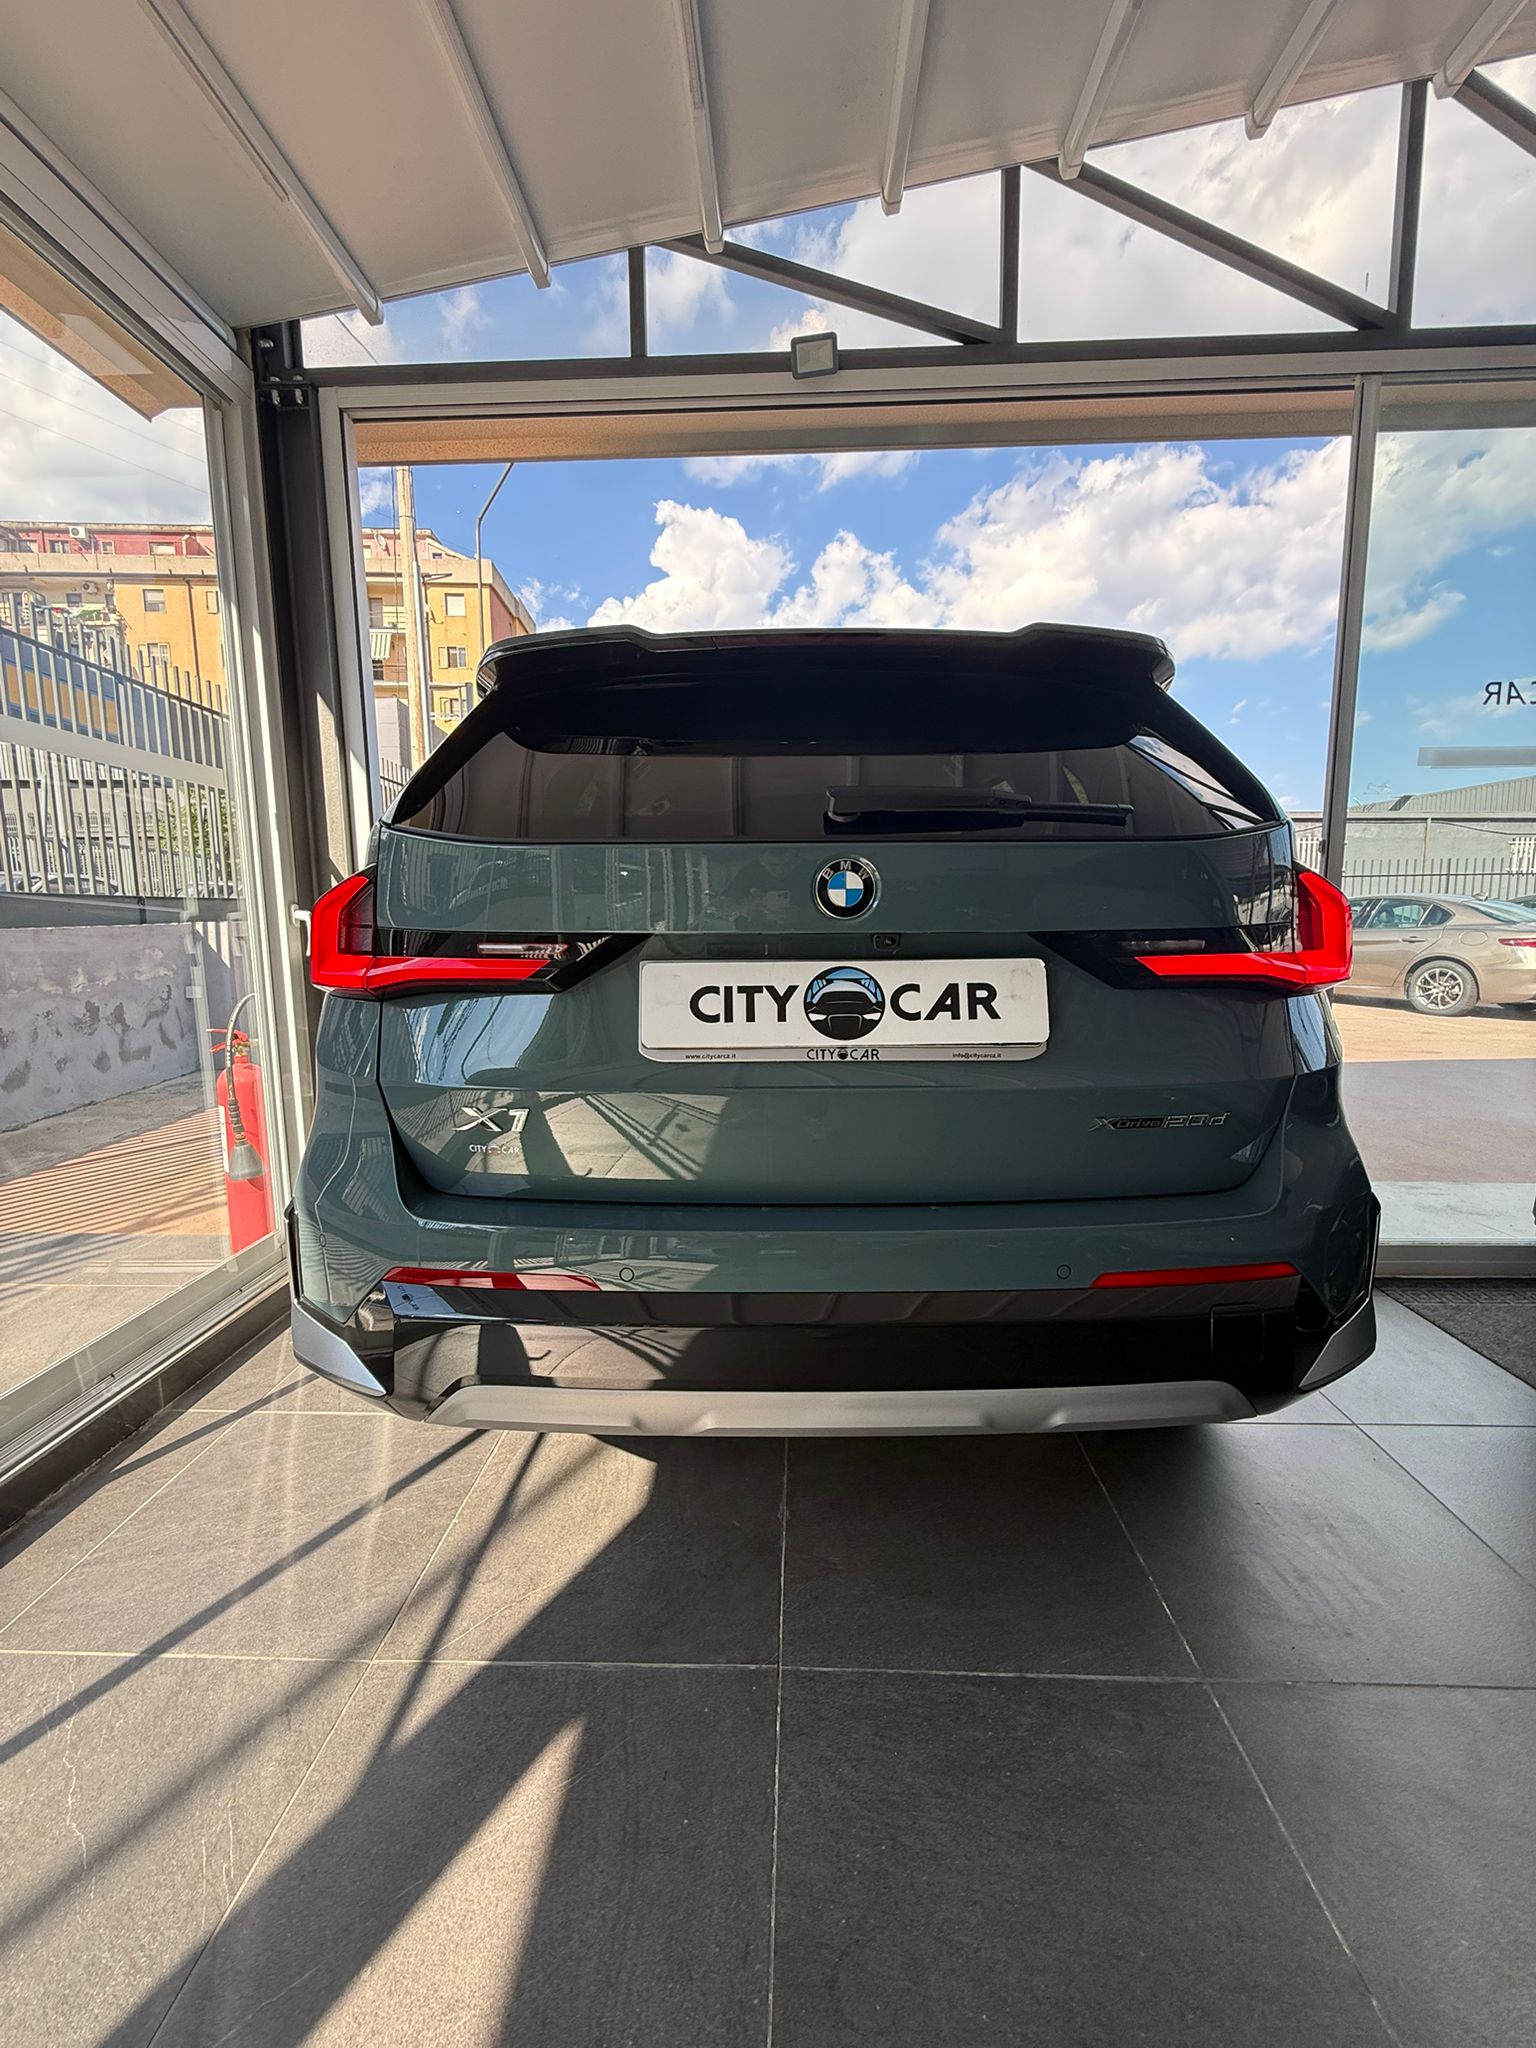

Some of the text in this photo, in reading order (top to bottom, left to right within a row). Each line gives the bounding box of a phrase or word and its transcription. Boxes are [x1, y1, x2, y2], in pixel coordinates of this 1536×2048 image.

[822, 860, 870, 880] BMW
[689, 983, 1001, 1023] CITY CAR
[806, 1048, 880, 1060] CITY CAR
[452, 1106, 529, 1132] X1
[469, 1144, 520, 1154] CITY CAR
